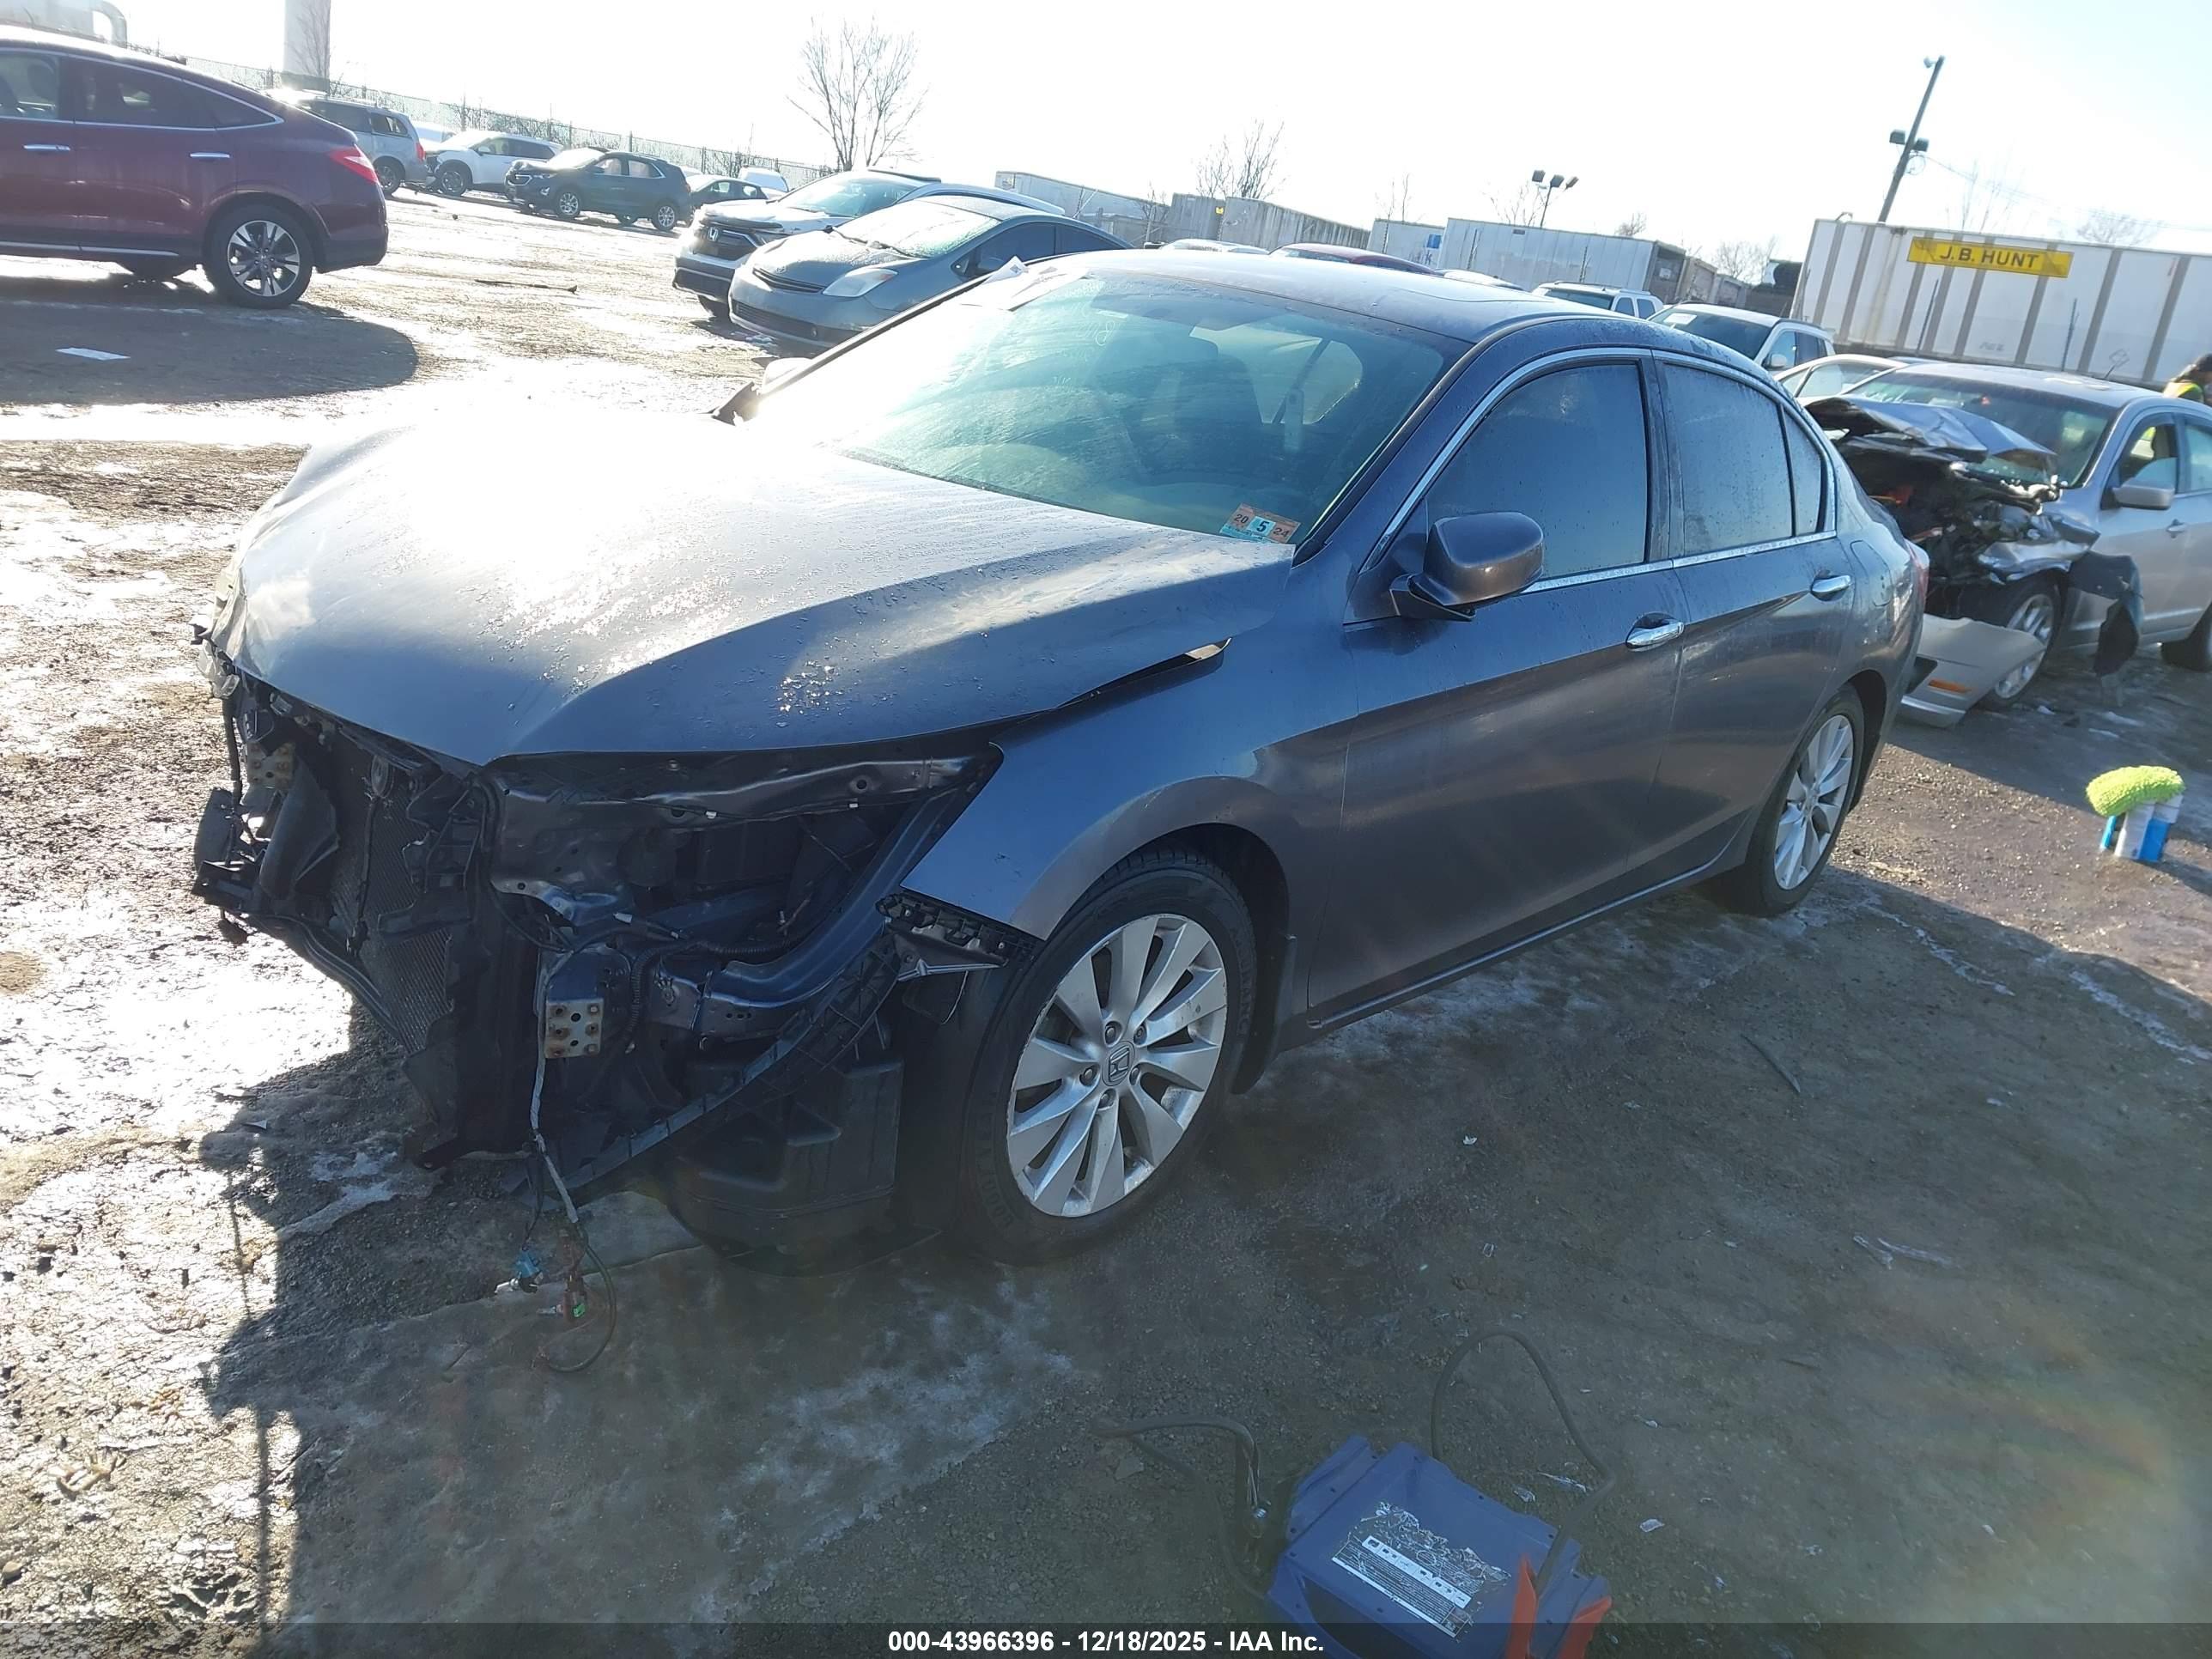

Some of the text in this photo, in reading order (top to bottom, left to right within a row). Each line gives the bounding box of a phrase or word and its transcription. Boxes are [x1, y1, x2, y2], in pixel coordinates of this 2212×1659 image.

[1981, 249, 2040, 268] HUNT
[1233, 514, 1249, 524] 20
[1256, 520, 1270, 532] 5
[1273, 527, 1290, 538] 24
